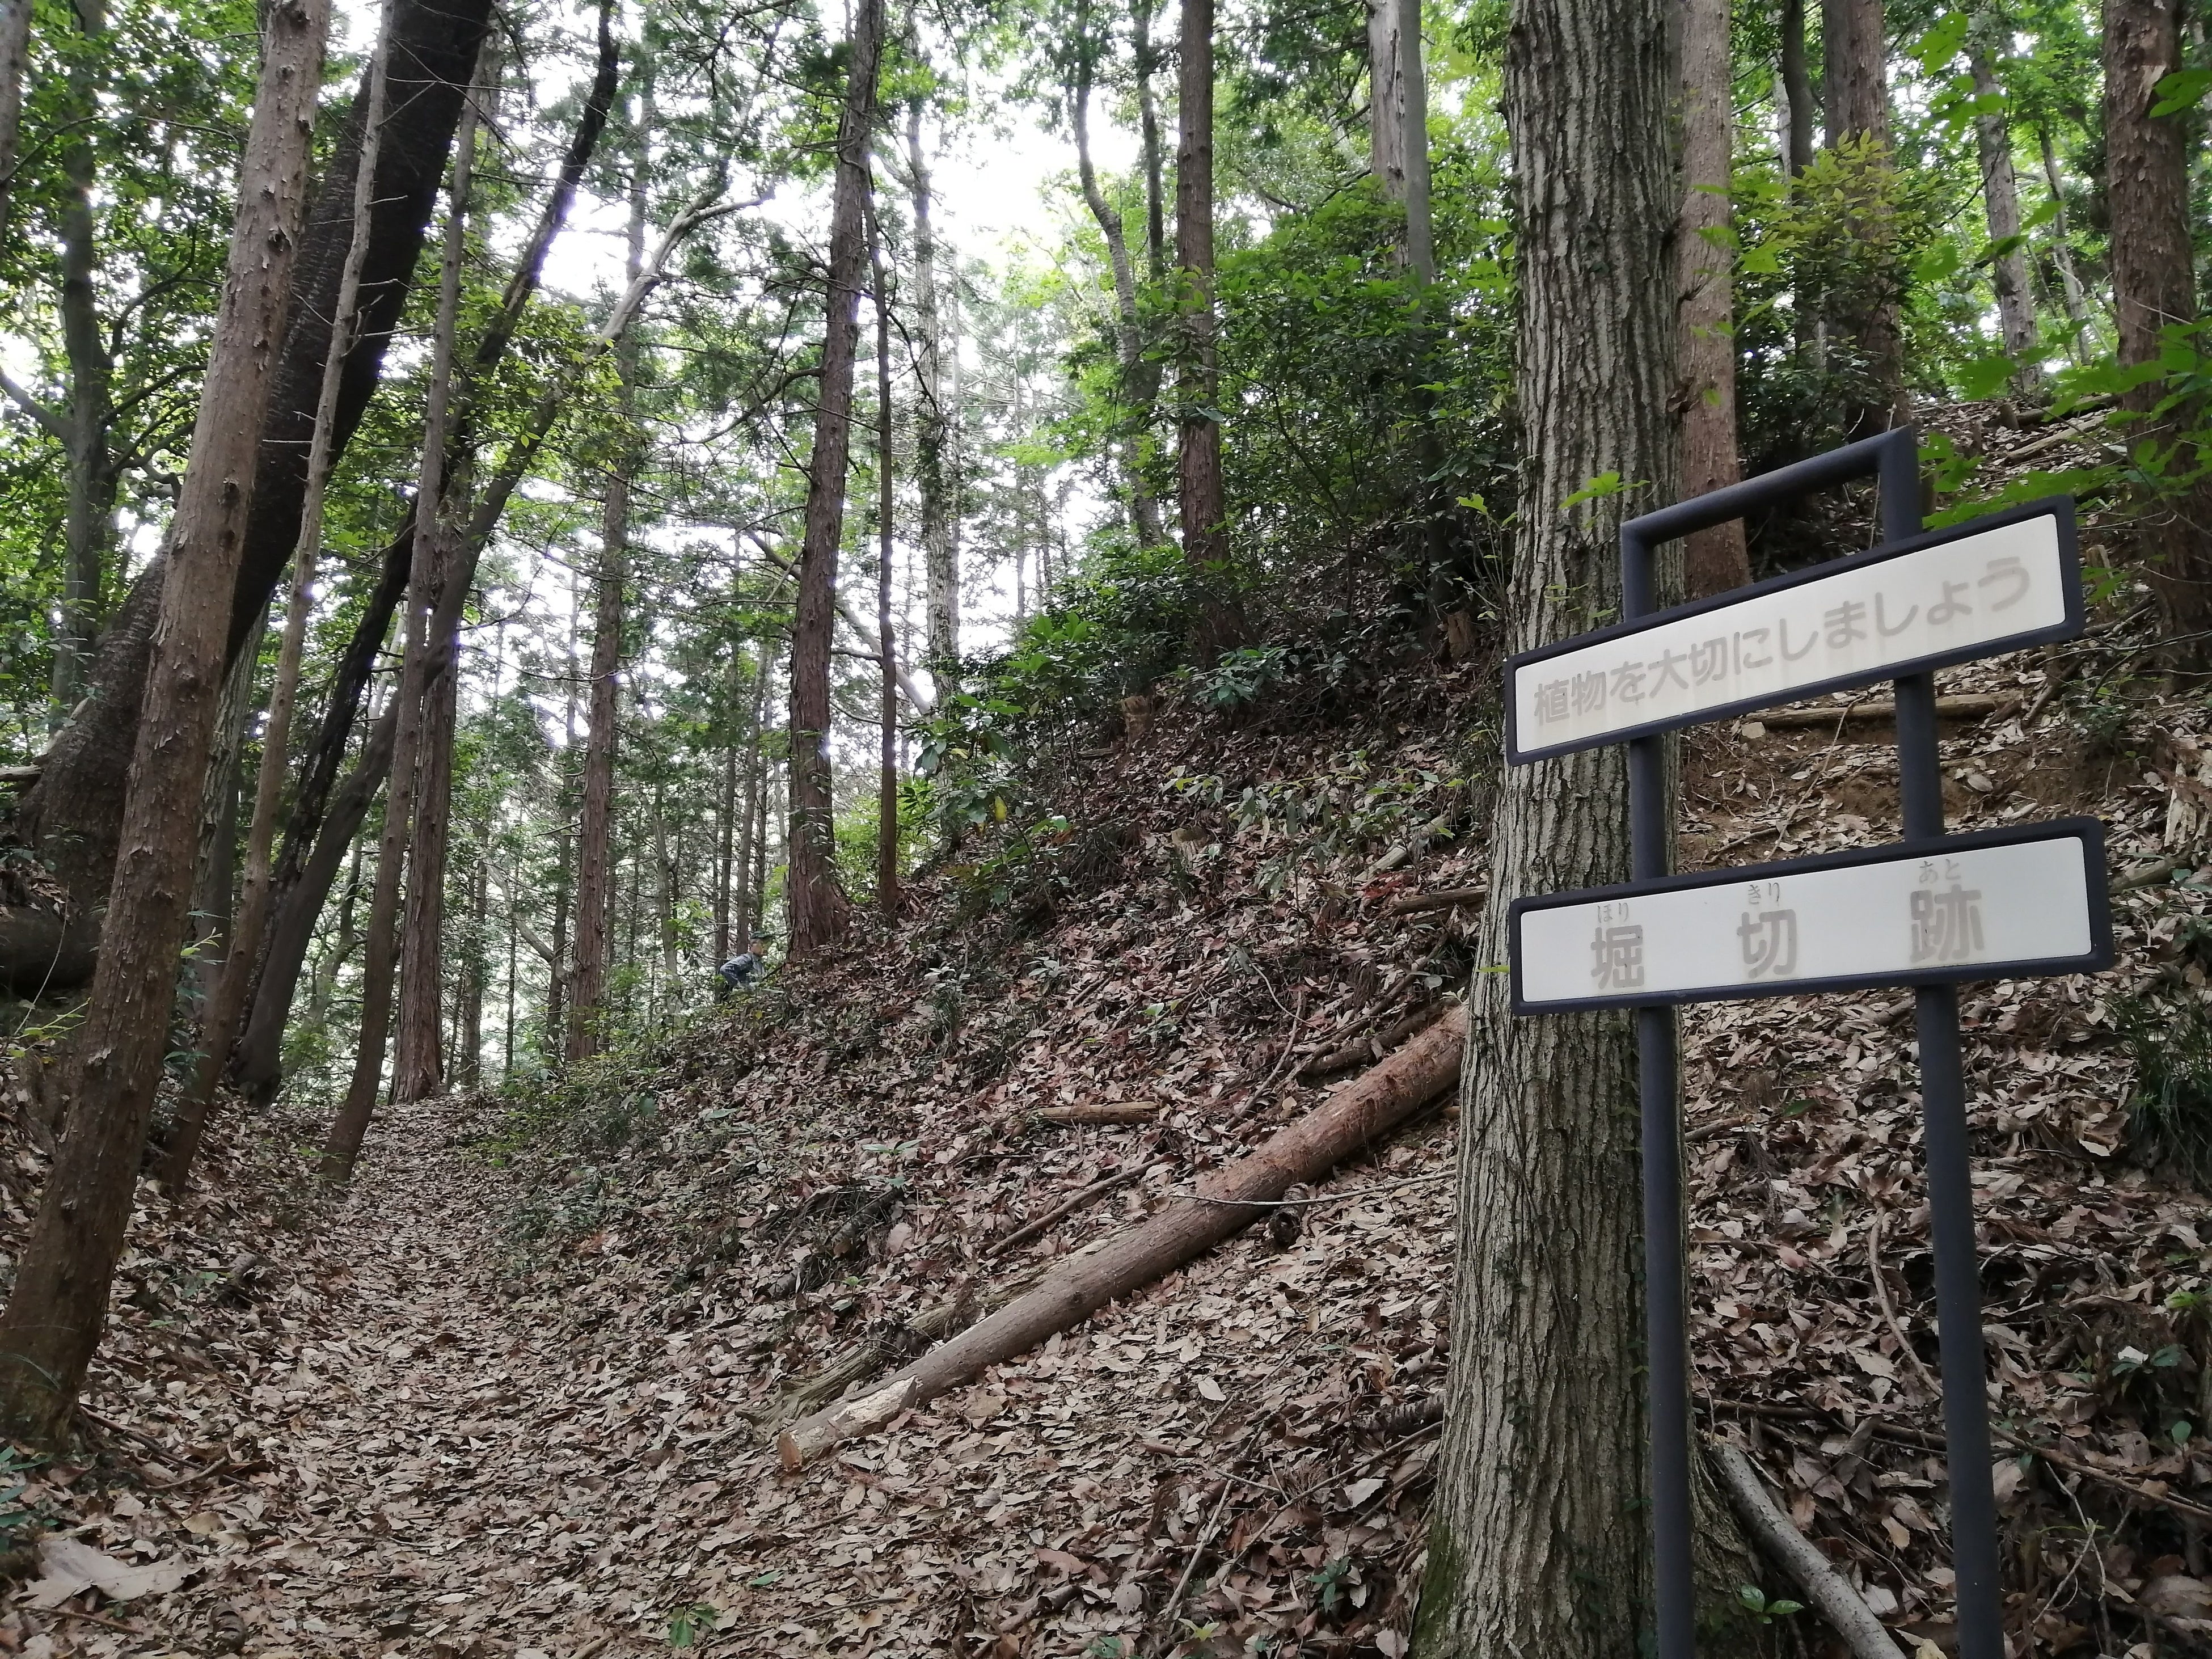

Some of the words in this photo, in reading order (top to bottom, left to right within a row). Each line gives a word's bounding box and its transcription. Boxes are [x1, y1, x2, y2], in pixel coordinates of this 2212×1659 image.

[1534, 555, 2031, 725] 植物を大切にしましょう
[1597, 902, 1630, 923] ほり
[1747, 882, 1782, 906] きり
[1918, 858, 1961, 882] あと
